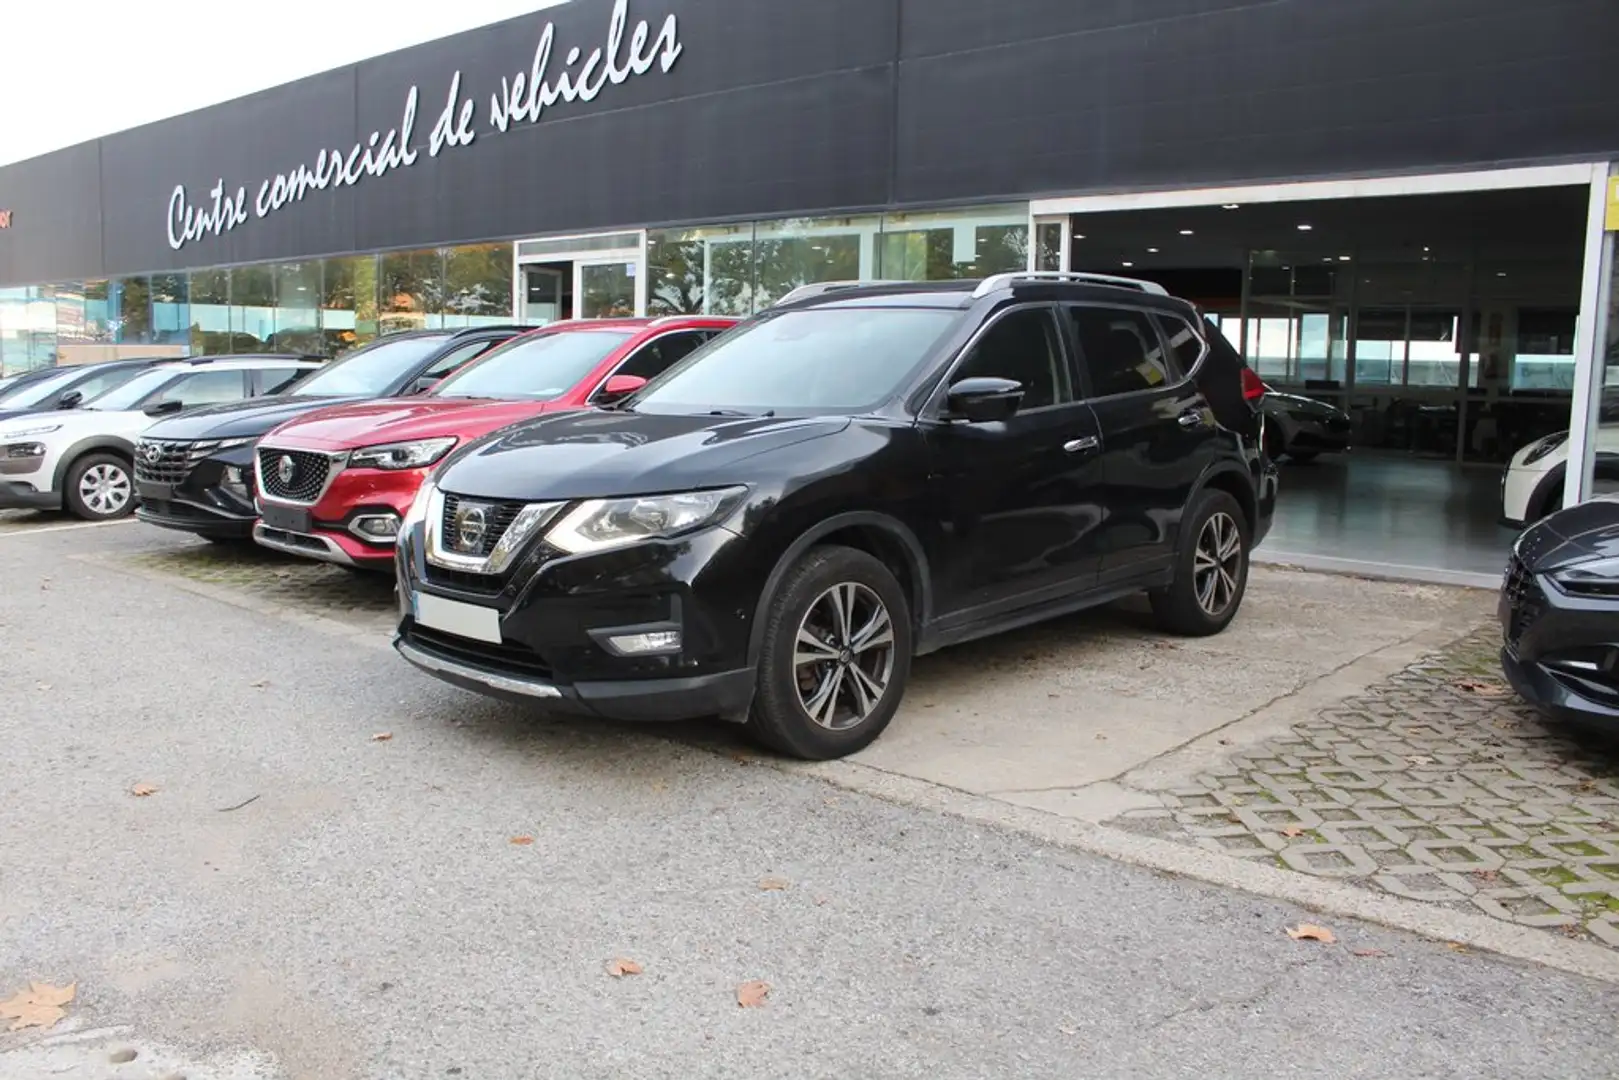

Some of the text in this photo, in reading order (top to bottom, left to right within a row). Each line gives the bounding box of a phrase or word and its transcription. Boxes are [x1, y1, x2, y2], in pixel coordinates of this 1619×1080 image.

[167, 0, 682, 250] Centre comercial de vehicles
